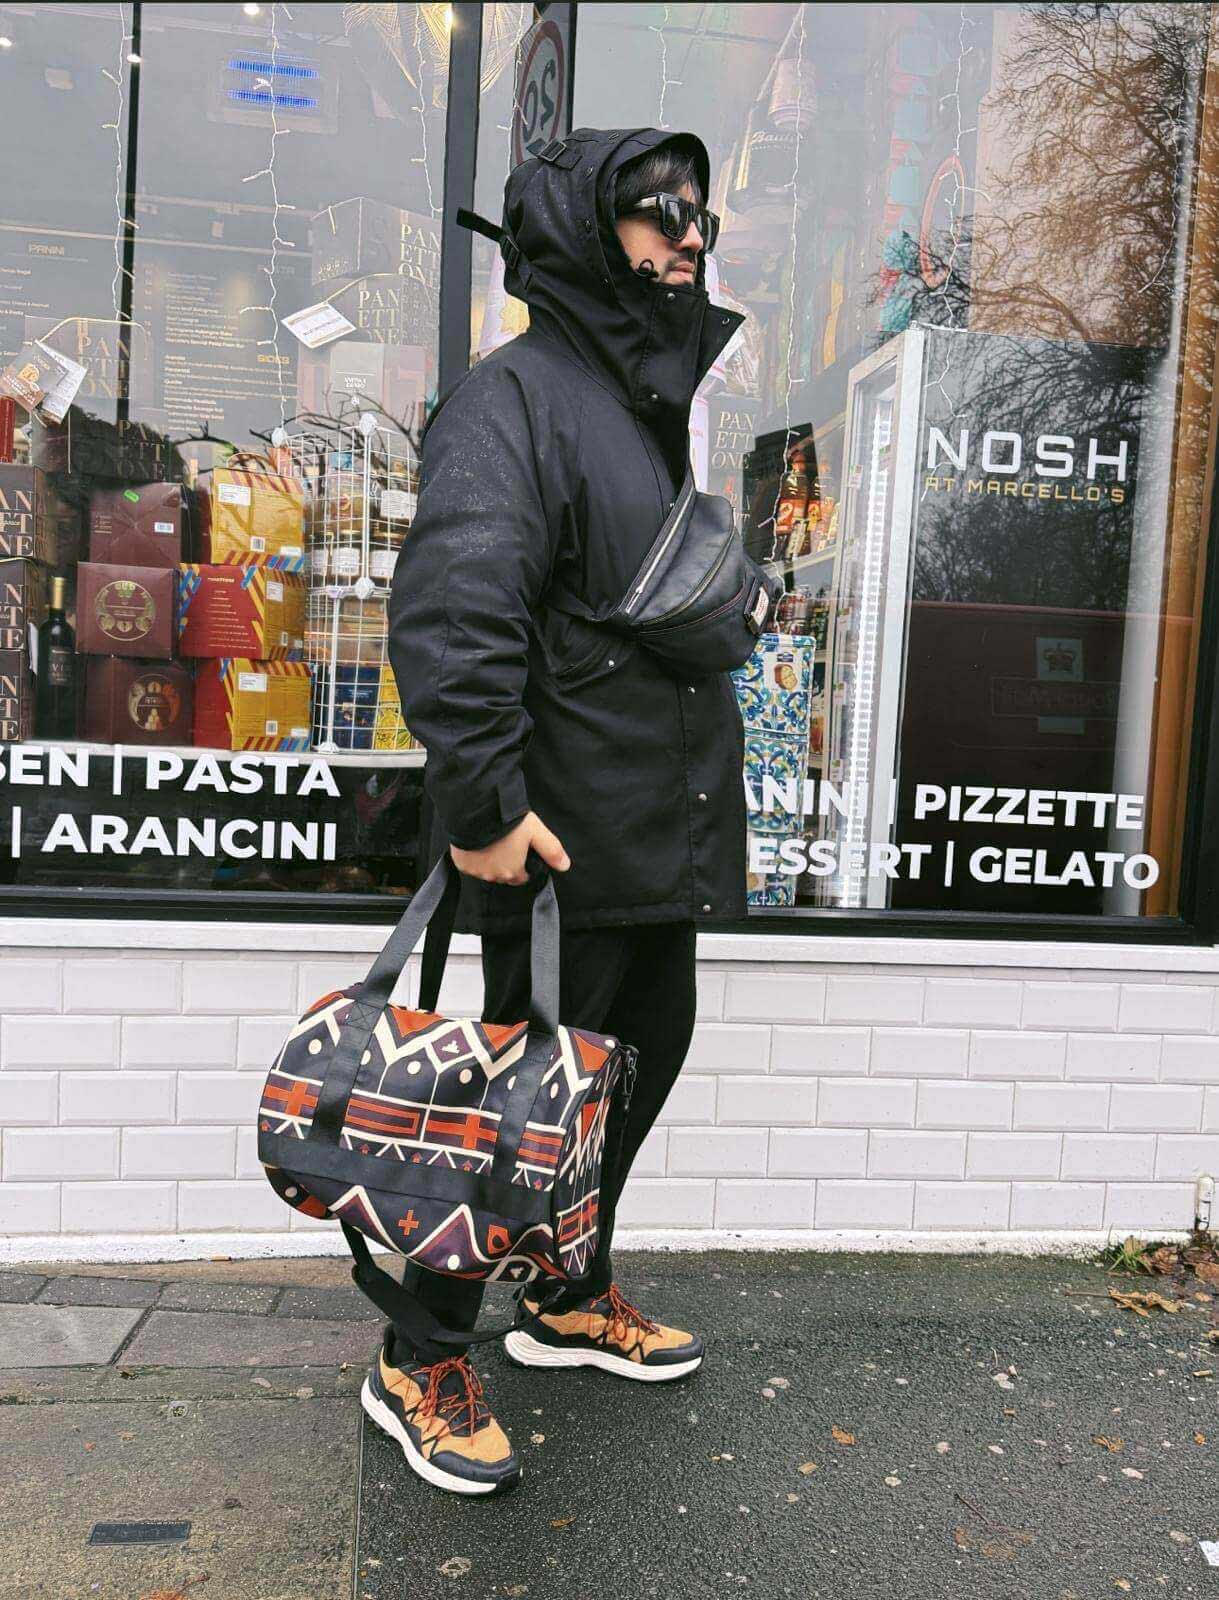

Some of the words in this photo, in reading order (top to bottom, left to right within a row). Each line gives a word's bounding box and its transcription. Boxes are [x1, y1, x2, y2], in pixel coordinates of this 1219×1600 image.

[927, 427, 1129, 482] NOSH
[925, 477, 956, 492] AT
[967, 480, 1126, 504] MARCELLO'S
[0, 745, 90, 787] EN
[146, 751, 341, 797] PASTA
[914, 784, 1145, 829] PIZZETTE
[40, 813, 337, 861] ARANCINI
[969, 846, 1160, 890] GELATO
